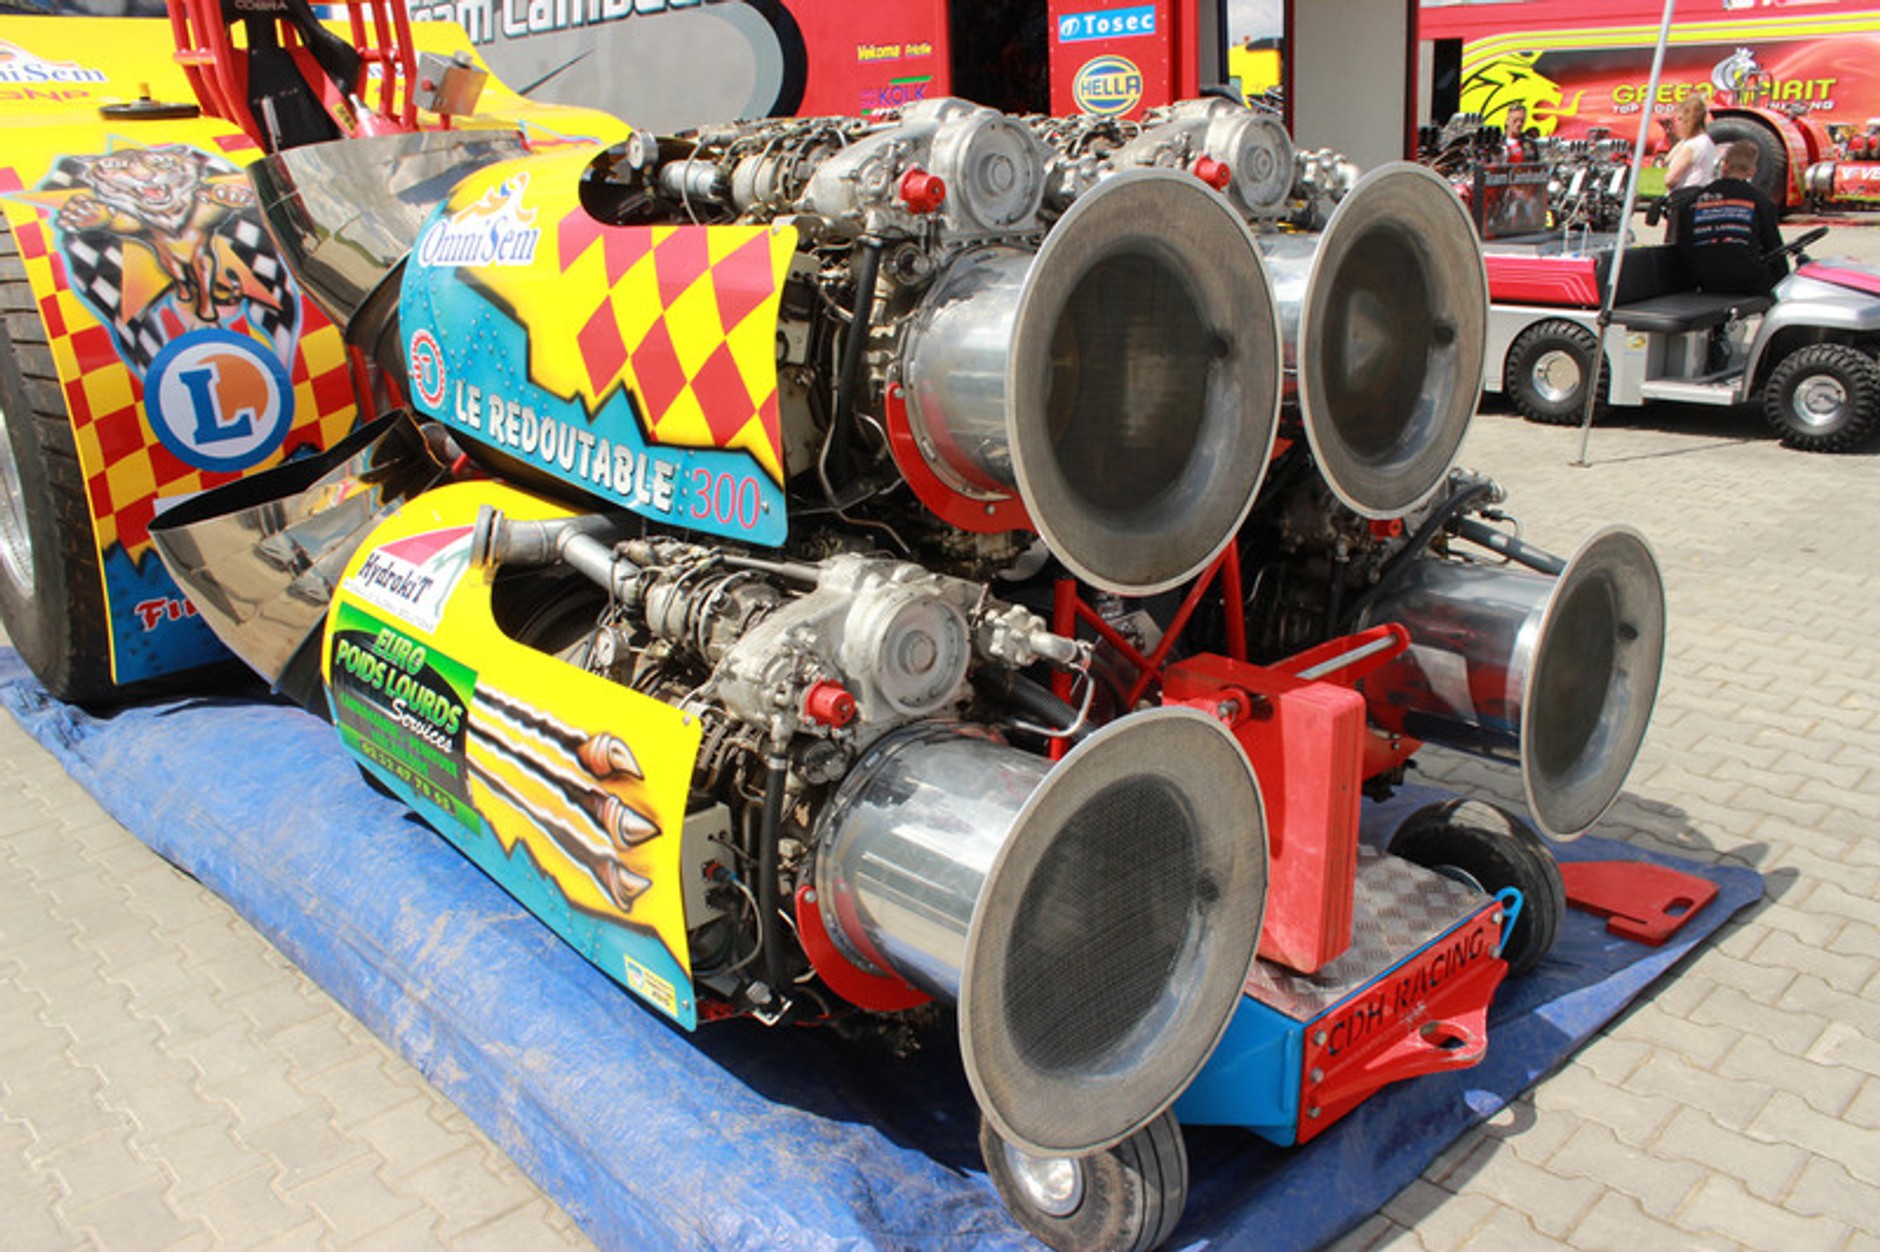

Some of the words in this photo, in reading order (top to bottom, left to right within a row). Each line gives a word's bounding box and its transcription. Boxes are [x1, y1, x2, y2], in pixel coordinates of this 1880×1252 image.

[1084, 14, 1153, 34] Tosec
[1081, 75, 1141, 96] HELLA
[423, 215, 539, 263] OmniSem
[455, 379, 482, 429] LE
[487, 393, 676, 514] REDOUTABLE
[690, 467, 762, 530] 300
[372, 627, 427, 676] EURO
[335, 638, 388, 689] POIDS
[385, 668, 464, 734] LOURDS
[390, 697, 454, 754] Services
[1328, 993, 1386, 1056] CDH
[1393, 927, 1484, 1015] RACING
